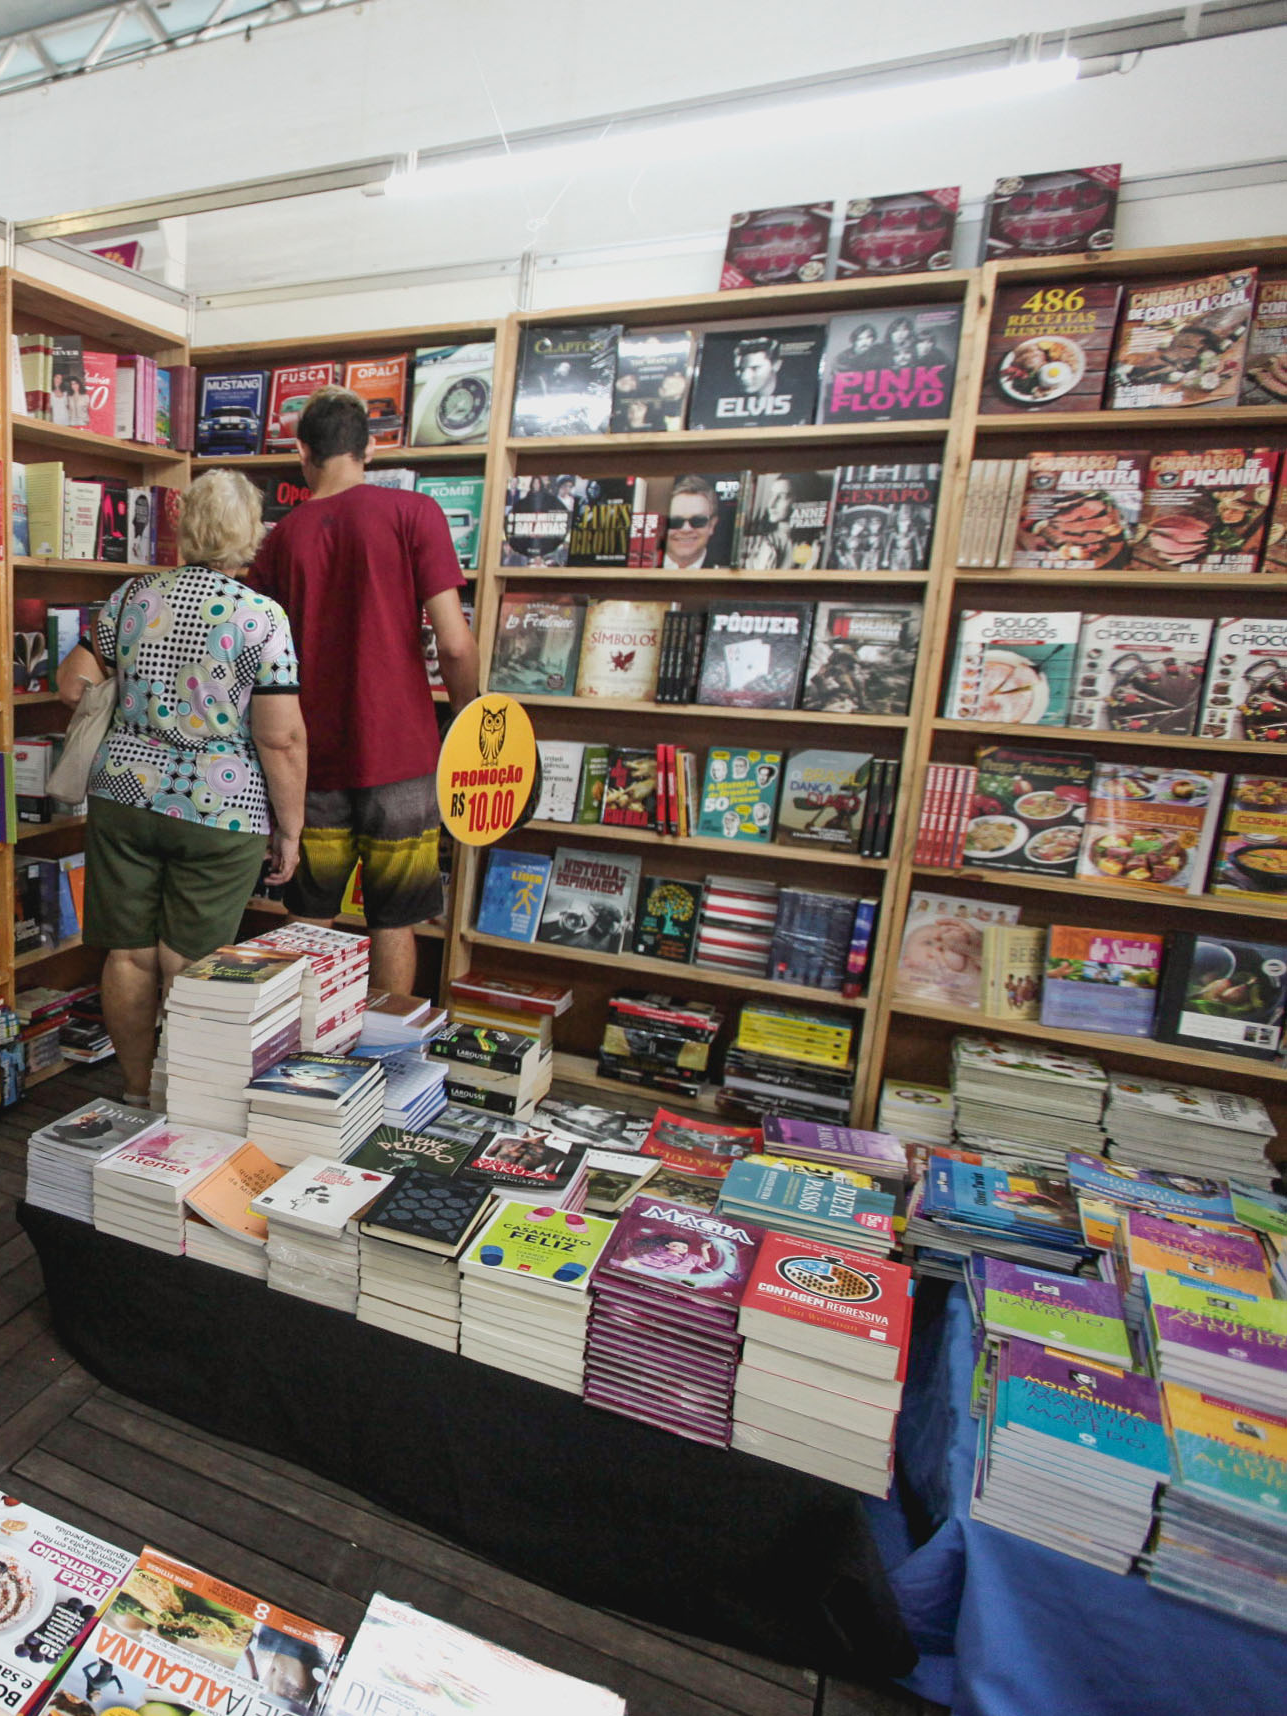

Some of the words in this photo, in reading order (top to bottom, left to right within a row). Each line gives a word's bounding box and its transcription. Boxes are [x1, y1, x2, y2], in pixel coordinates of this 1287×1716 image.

[1021, 287, 1086, 314] 486
[1131, 279, 1228, 308] CHURRASCO
[1007, 311, 1097, 328] RECEITAS
[280, 370, 326, 383] FUSCA
[357, 364, 400, 379] OPALA
[832, 365, 946, 394] PINK
[207, 378, 260, 391] MUSTANG
[716, 395, 793, 418] ELVIS
[830, 388, 945, 413] FLOYD
[1030, 456, 1117, 470] CHURRASCO
[1057, 470, 1140, 485] ALCATRA
[1181, 468, 1269, 486] PICANHA
[430, 485, 475, 498] KOMBI
[836, 489, 930, 504] GESTAPO
[792, 508, 827, 520] ANNE
[713, 611, 799, 635] PÔQUER
[993, 617, 1048, 629] BOLOS
[590, 630, 658, 647] SÍMBOLOS
[982, 628, 1057, 640] CASEIROS
[1095, 629, 1200, 645] CHOCOLATE
[1228, 634, 1287, 647] CHOC
[451, 765, 523, 788] PROMOÇÃO
[450, 791, 465, 818] R$
[468, 790, 515, 833] 10,00
[1236, 814, 1287, 827] COZINH
[563, 858, 620, 880] HISTÓRIA
[1089, 937, 1110, 953] de
[1112, 940, 1159, 965] Saúde
[456, 1050, 492, 1062] LAROUSSE
[451, 1088, 487, 1101] LAROUSSE
[401, 1134, 452, 1151] PEIXE
[817, 1125, 835, 1150] AMOR
[377, 1140, 456, 1164] PELUDO
[476, 1160, 549, 1180] YAKUZA
[798, 1178, 824, 1213] PASSOS
[828, 1185, 858, 1219] DIETA
[503, 1223, 592, 1247] CASAMENTO
[640, 1205, 755, 1246] MAGIA
[509, 1231, 577, 1253] FELIZ
[757, 1282, 825, 1308] CONTAGEM
[826, 1301, 889, 1326] REGRESSIVA
[1024, 1375, 1148, 1421] MORENINHA
[1077, 1384, 1093, 1394] A
[59, 1569, 108, 1601] Dieta
[254, 1602, 271, 1621] 8
[95, 1625, 233, 1710] ALCALINA
[21, 1678, 33, 1690] e
